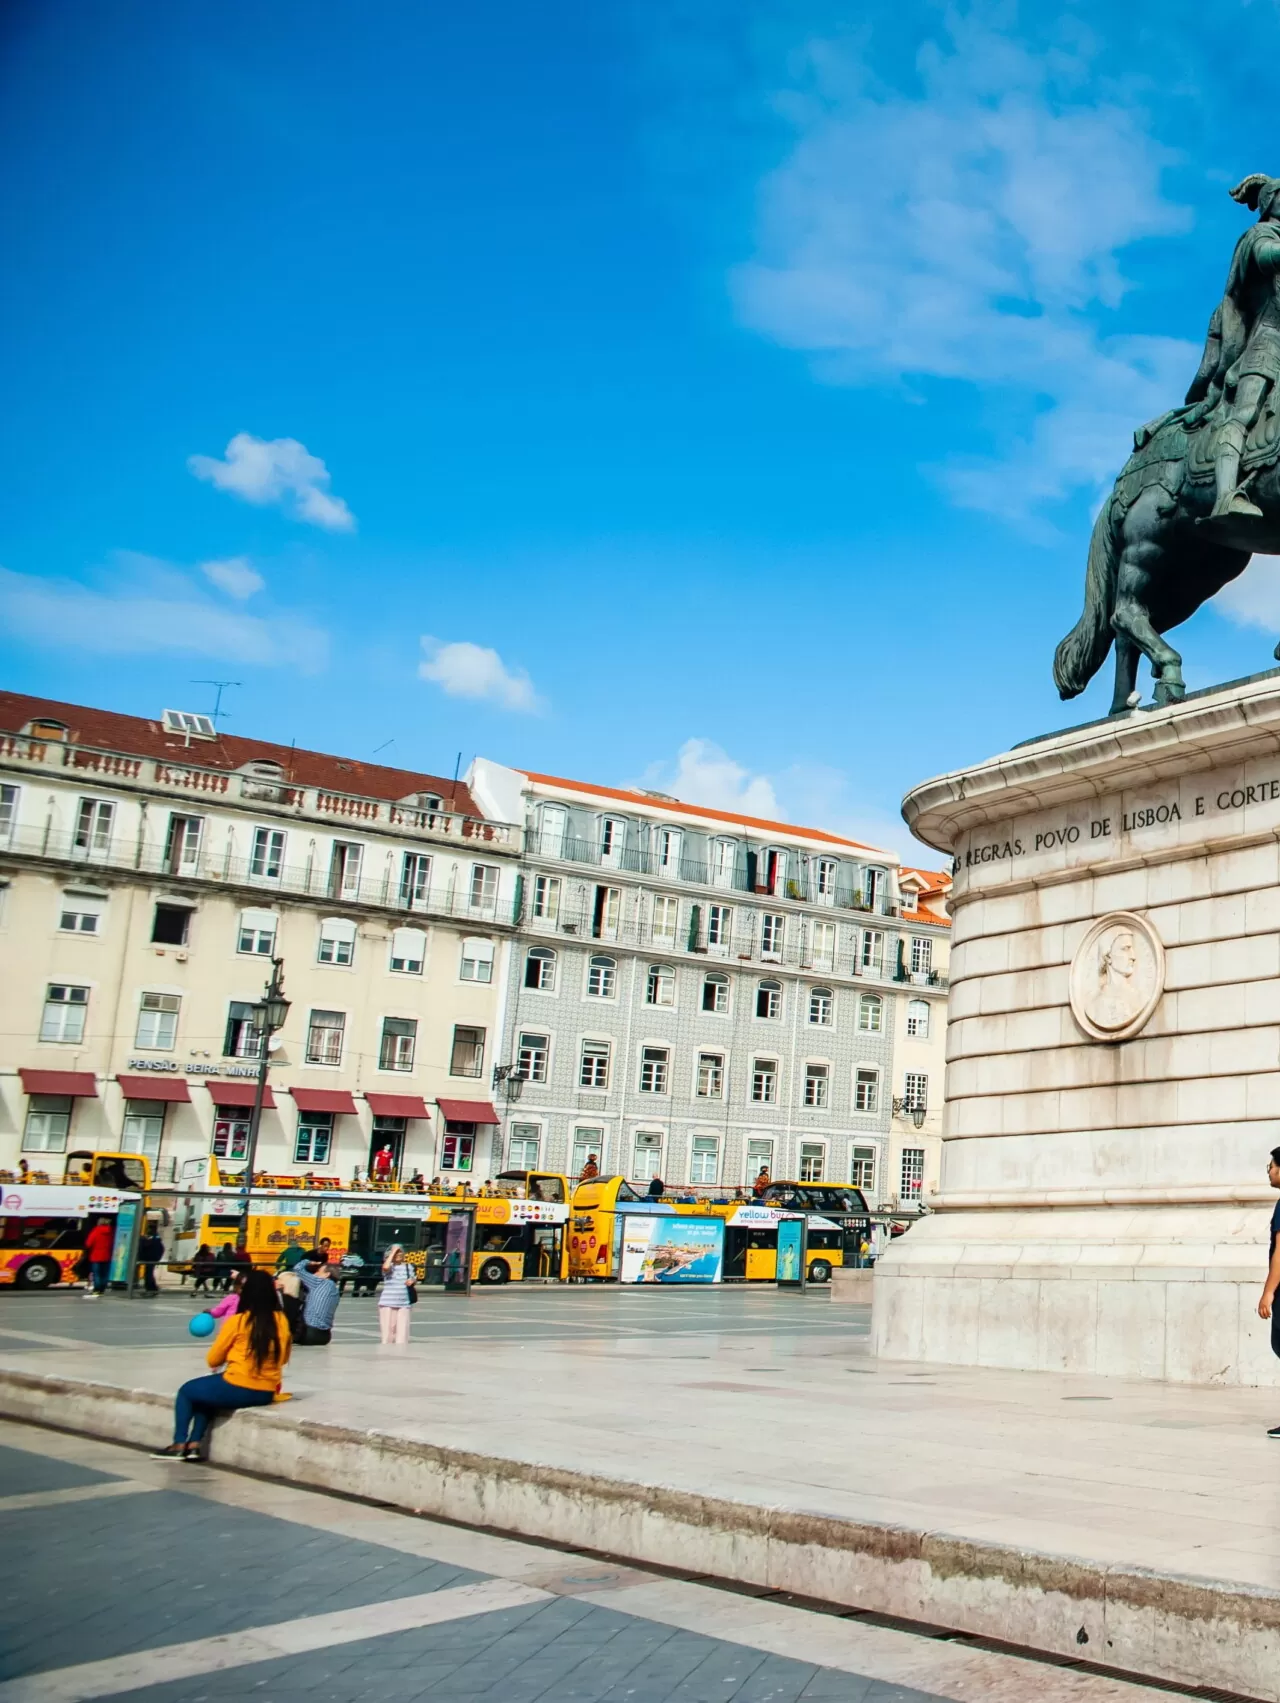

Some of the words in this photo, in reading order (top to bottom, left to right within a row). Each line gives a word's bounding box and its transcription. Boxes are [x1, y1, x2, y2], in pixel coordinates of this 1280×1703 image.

[966, 839, 1026, 867] REGRAS,
[1035, 826, 1080, 851] POVO
[1090, 818, 1111, 839] DE
[1123, 802, 1182, 832] LISBOA
[1195, 796, 1205, 816] E
[128, 1059, 179, 1072] PENSÃO
[185, 1063, 221, 1075] BEIRA
